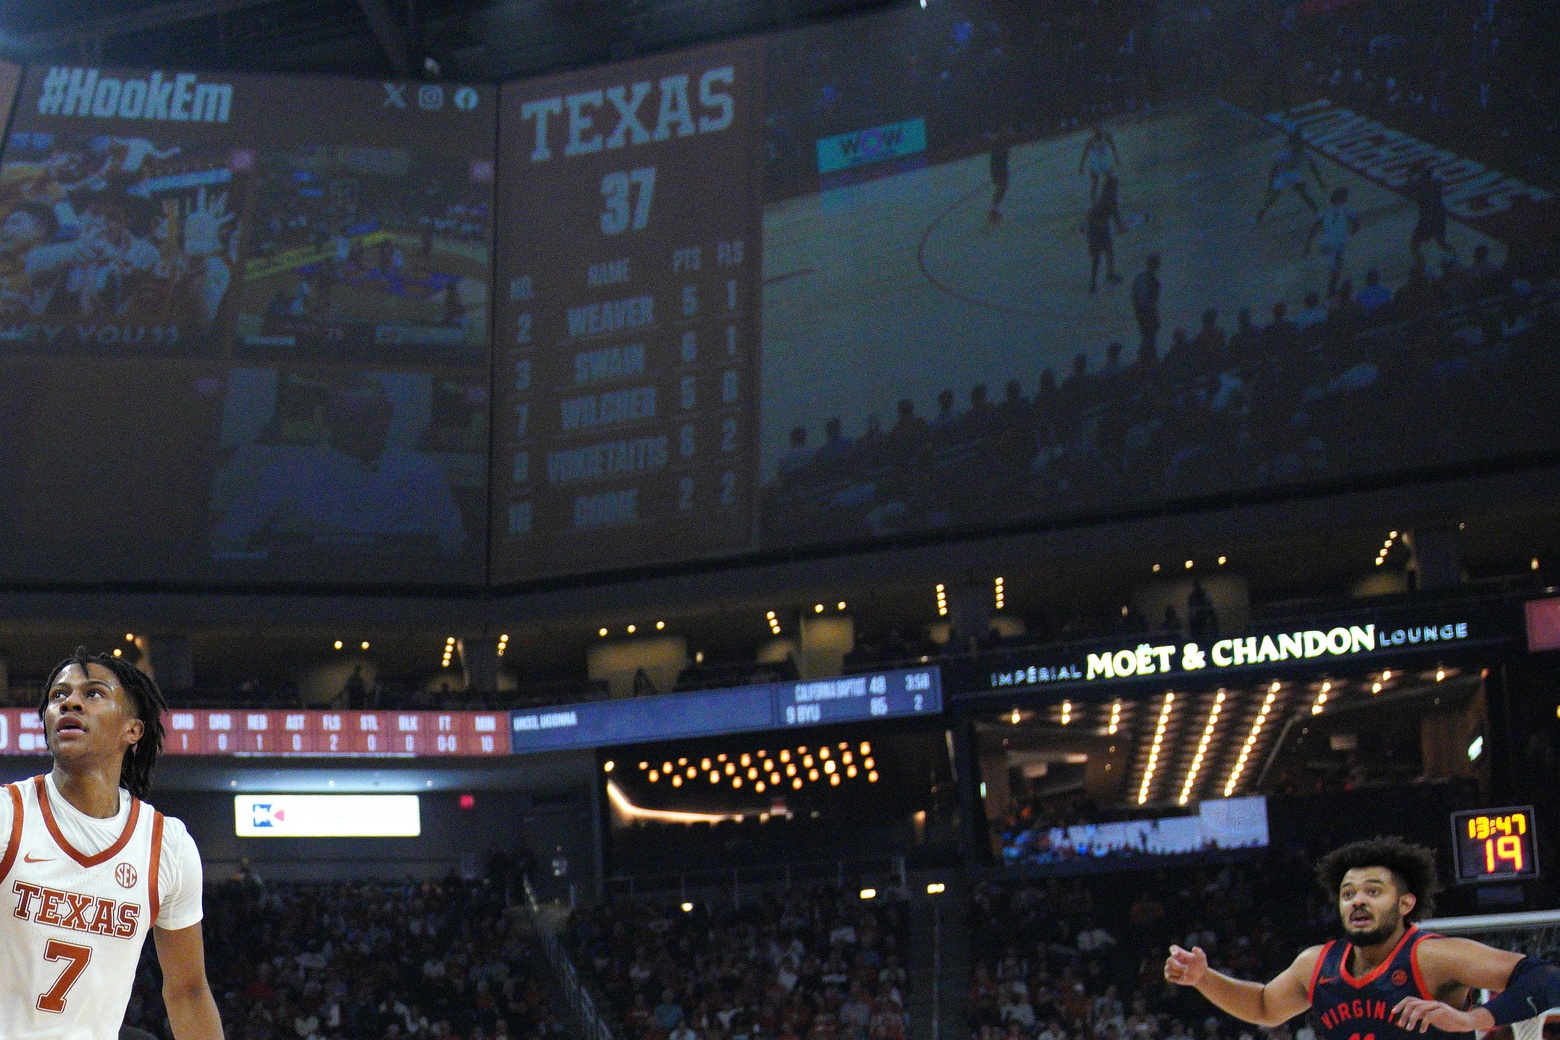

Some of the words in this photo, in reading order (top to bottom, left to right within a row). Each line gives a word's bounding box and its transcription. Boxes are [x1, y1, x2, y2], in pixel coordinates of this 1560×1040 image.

[39, 66, 233, 123] #HookEm
[521, 65, 736, 163] TEXAS
[600, 167, 657, 235] 37
[587, 257, 630, 287] NAME
[673, 246, 702, 272] PTS
[566, 294, 655, 338] WEAVER
[726, 279, 738, 310] 1
[726, 325, 737, 356] 1
[515, 403, 530, 438] 7
[721, 417, 737, 452] 2
[679, 476, 694, 510] 2
[720, 471, 736, 505] 2
[1086, 643, 1176, 681] MOËT
[1182, 643, 1207, 670] &
[1211, 624, 1376, 667] CHANDON
[1380, 622, 1469, 646] LOUNGE
[285, 714, 305, 731] AST
[330, 734, 339, 751] 2
[481, 734, 494, 752] 10
[1468, 814, 1526, 839] 13:47
[1486, 836, 1523, 873] 19
[115, 862, 138, 887] SEC
[12, 880, 142, 940] TEXAS
[36, 938, 93, 1014] 7
